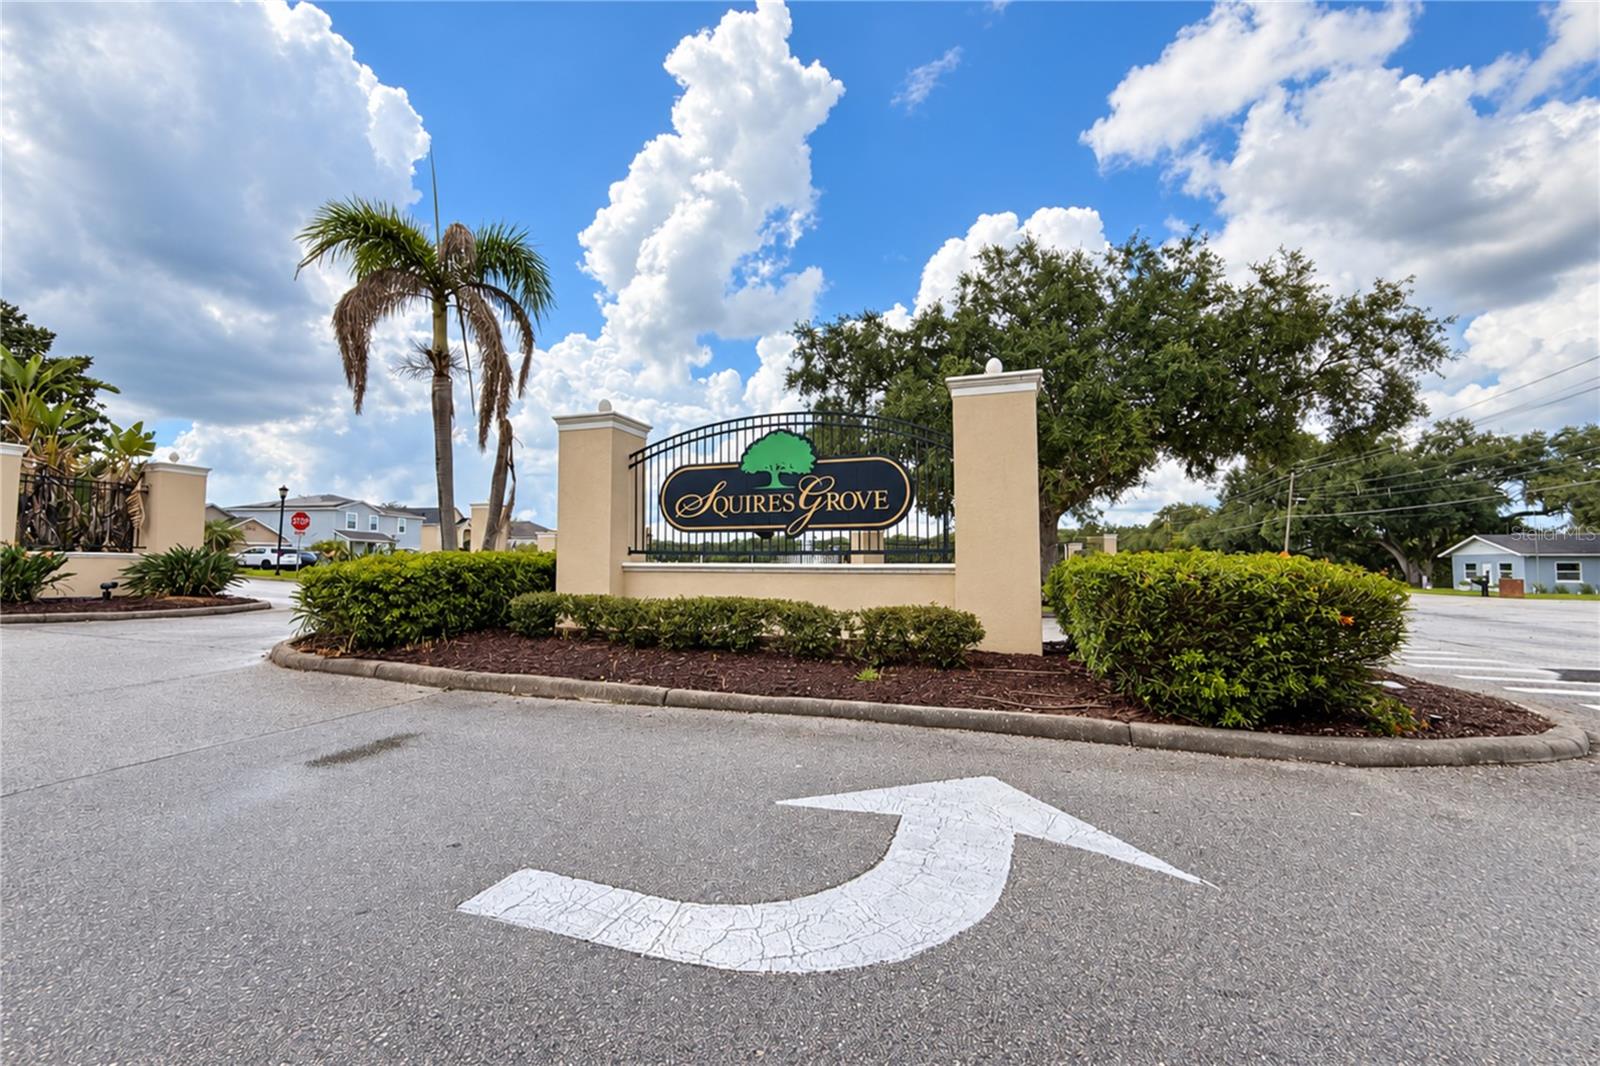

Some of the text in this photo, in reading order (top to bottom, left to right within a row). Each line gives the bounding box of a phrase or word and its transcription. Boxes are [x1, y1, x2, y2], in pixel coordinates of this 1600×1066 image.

[292, 517, 309, 525] STOP
[675, 475, 890, 535] SQUIRES GROVE
